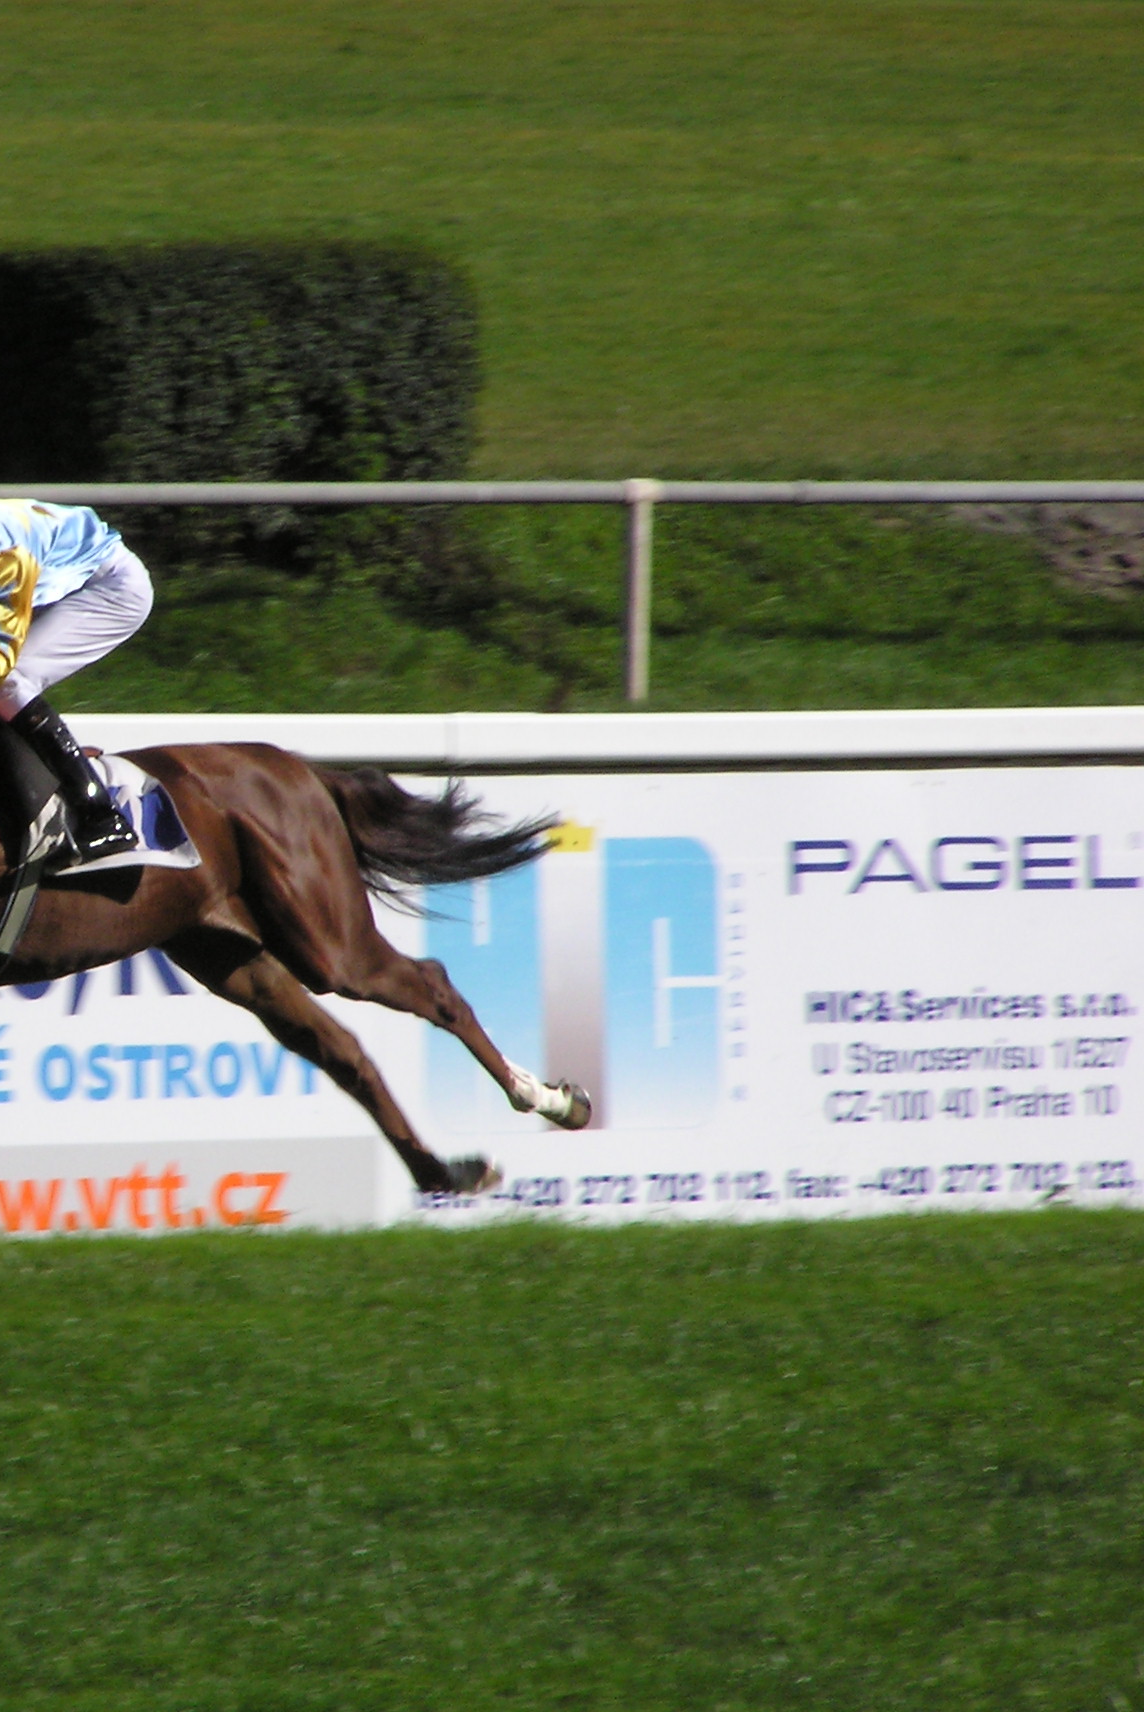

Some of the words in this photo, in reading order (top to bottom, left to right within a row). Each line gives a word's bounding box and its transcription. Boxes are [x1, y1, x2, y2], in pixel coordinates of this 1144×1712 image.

[787, 835, 1140, 895] PAGEL
[1051, 992, 1138, 1019] s.r.o.
[811, 1042, 840, 1076] U
[824, 1090, 935, 1123] CZ-100
[939, 1087, 980, 1120] 40
[982, 1084, 1076, 1119] Praha
[1079, 1083, 1121, 1117] 10
[575, 1174, 639, 1206] 272
[644, 1171, 705, 1203] 702
[785, 1166, 849, 1199] fax:
[856, 1164, 931, 1198] +420
[938, 1160, 1003, 1195] 272
[1006, 1159, 1067, 1192] 702
